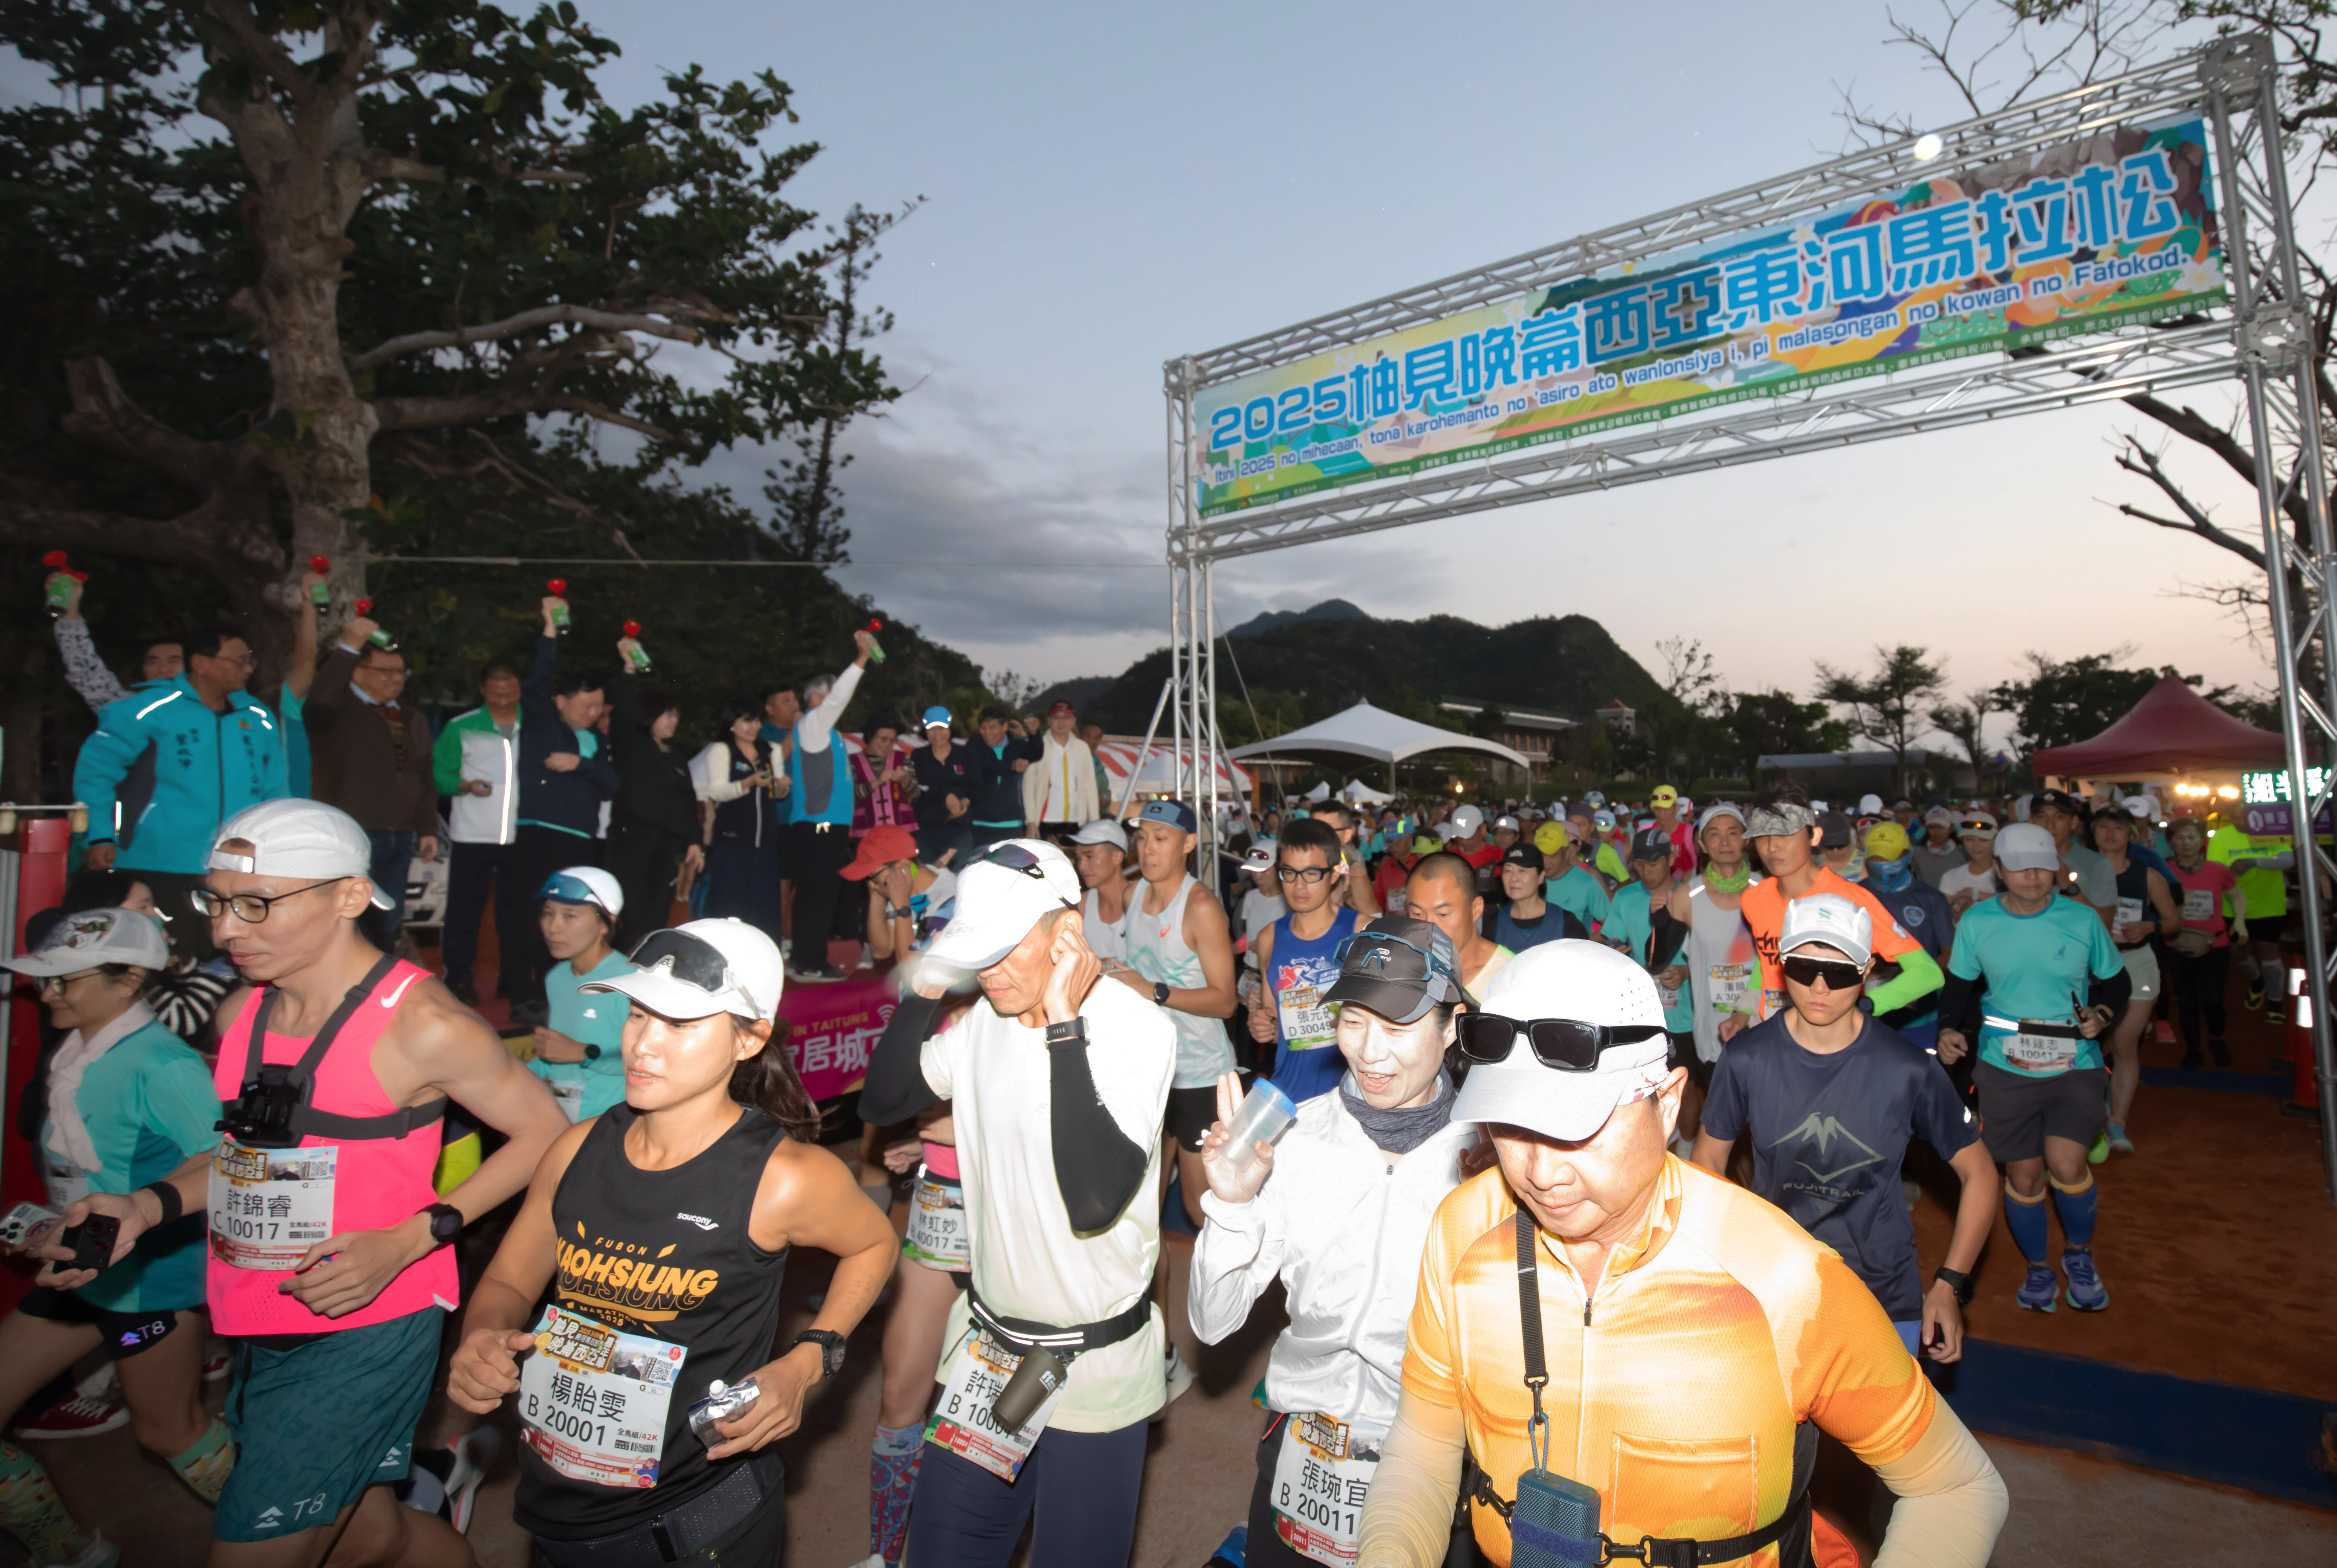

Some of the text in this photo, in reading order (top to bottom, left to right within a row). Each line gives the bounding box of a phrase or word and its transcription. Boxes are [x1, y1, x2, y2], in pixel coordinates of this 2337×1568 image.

[1215, 466, 1235, 483] Itini
[1240, 457, 1275, 476] 2025
[1281, 452, 1296, 466] no
[1302, 438, 1363, 459] mihecaan,
[1370, 428, 1400, 445] tona
[1407, 403, 1499, 435] karohemanto
[1508, 397, 1526, 412] no
[1588, 374, 1616, 393] ato
[1625, 350, 1722, 384] wanlonsiya
[1753, 336, 1768, 360] pi
[1778, 311, 1898, 349] malasongan
[1910, 302, 1936, 319] no
[1947, 286, 2021, 312] kowan
[2033, 275, 2063, 296] no
[2074, 246, 2189, 287] Fafokod.
[793, 1012, 868, 1037] IN TAITUNG
[1289, 1027, 1297, 1036] D
[2020, 1050, 2053, 1060] 10041
[1783, 1182, 1865, 1197] FUJITRAIL
[227, 1188, 292, 1218] 許錦睿
[214, 1210, 280, 1240] C 10017
[676, 1212, 711, 1225] saucony
[595, 1236, 648, 1255] FUBON
[911, 1224, 949, 1250] B 40017
[556, 1236, 719, 1296] KAOHSIUNG
[580, 1305, 637, 1326] MARATHON
[599, 1314, 624, 1327] 2025
[136, 1320, 166, 1339] T8
[551, 1371, 626, 1423] 楊貽雯
[948, 1394, 962, 1414] B
[527, 1393, 606, 1446] B 20001
[617, 1427, 658, 1441] 全馬組/42K
[539, 1443, 552, 1456] 20001
[1301, 1458, 1370, 1508] 張琬宜
[293, 1492, 326, 1521] T8
[1280, 1482, 1354, 1534] B 20011
[1293, 1533, 1307, 1546] 20011
